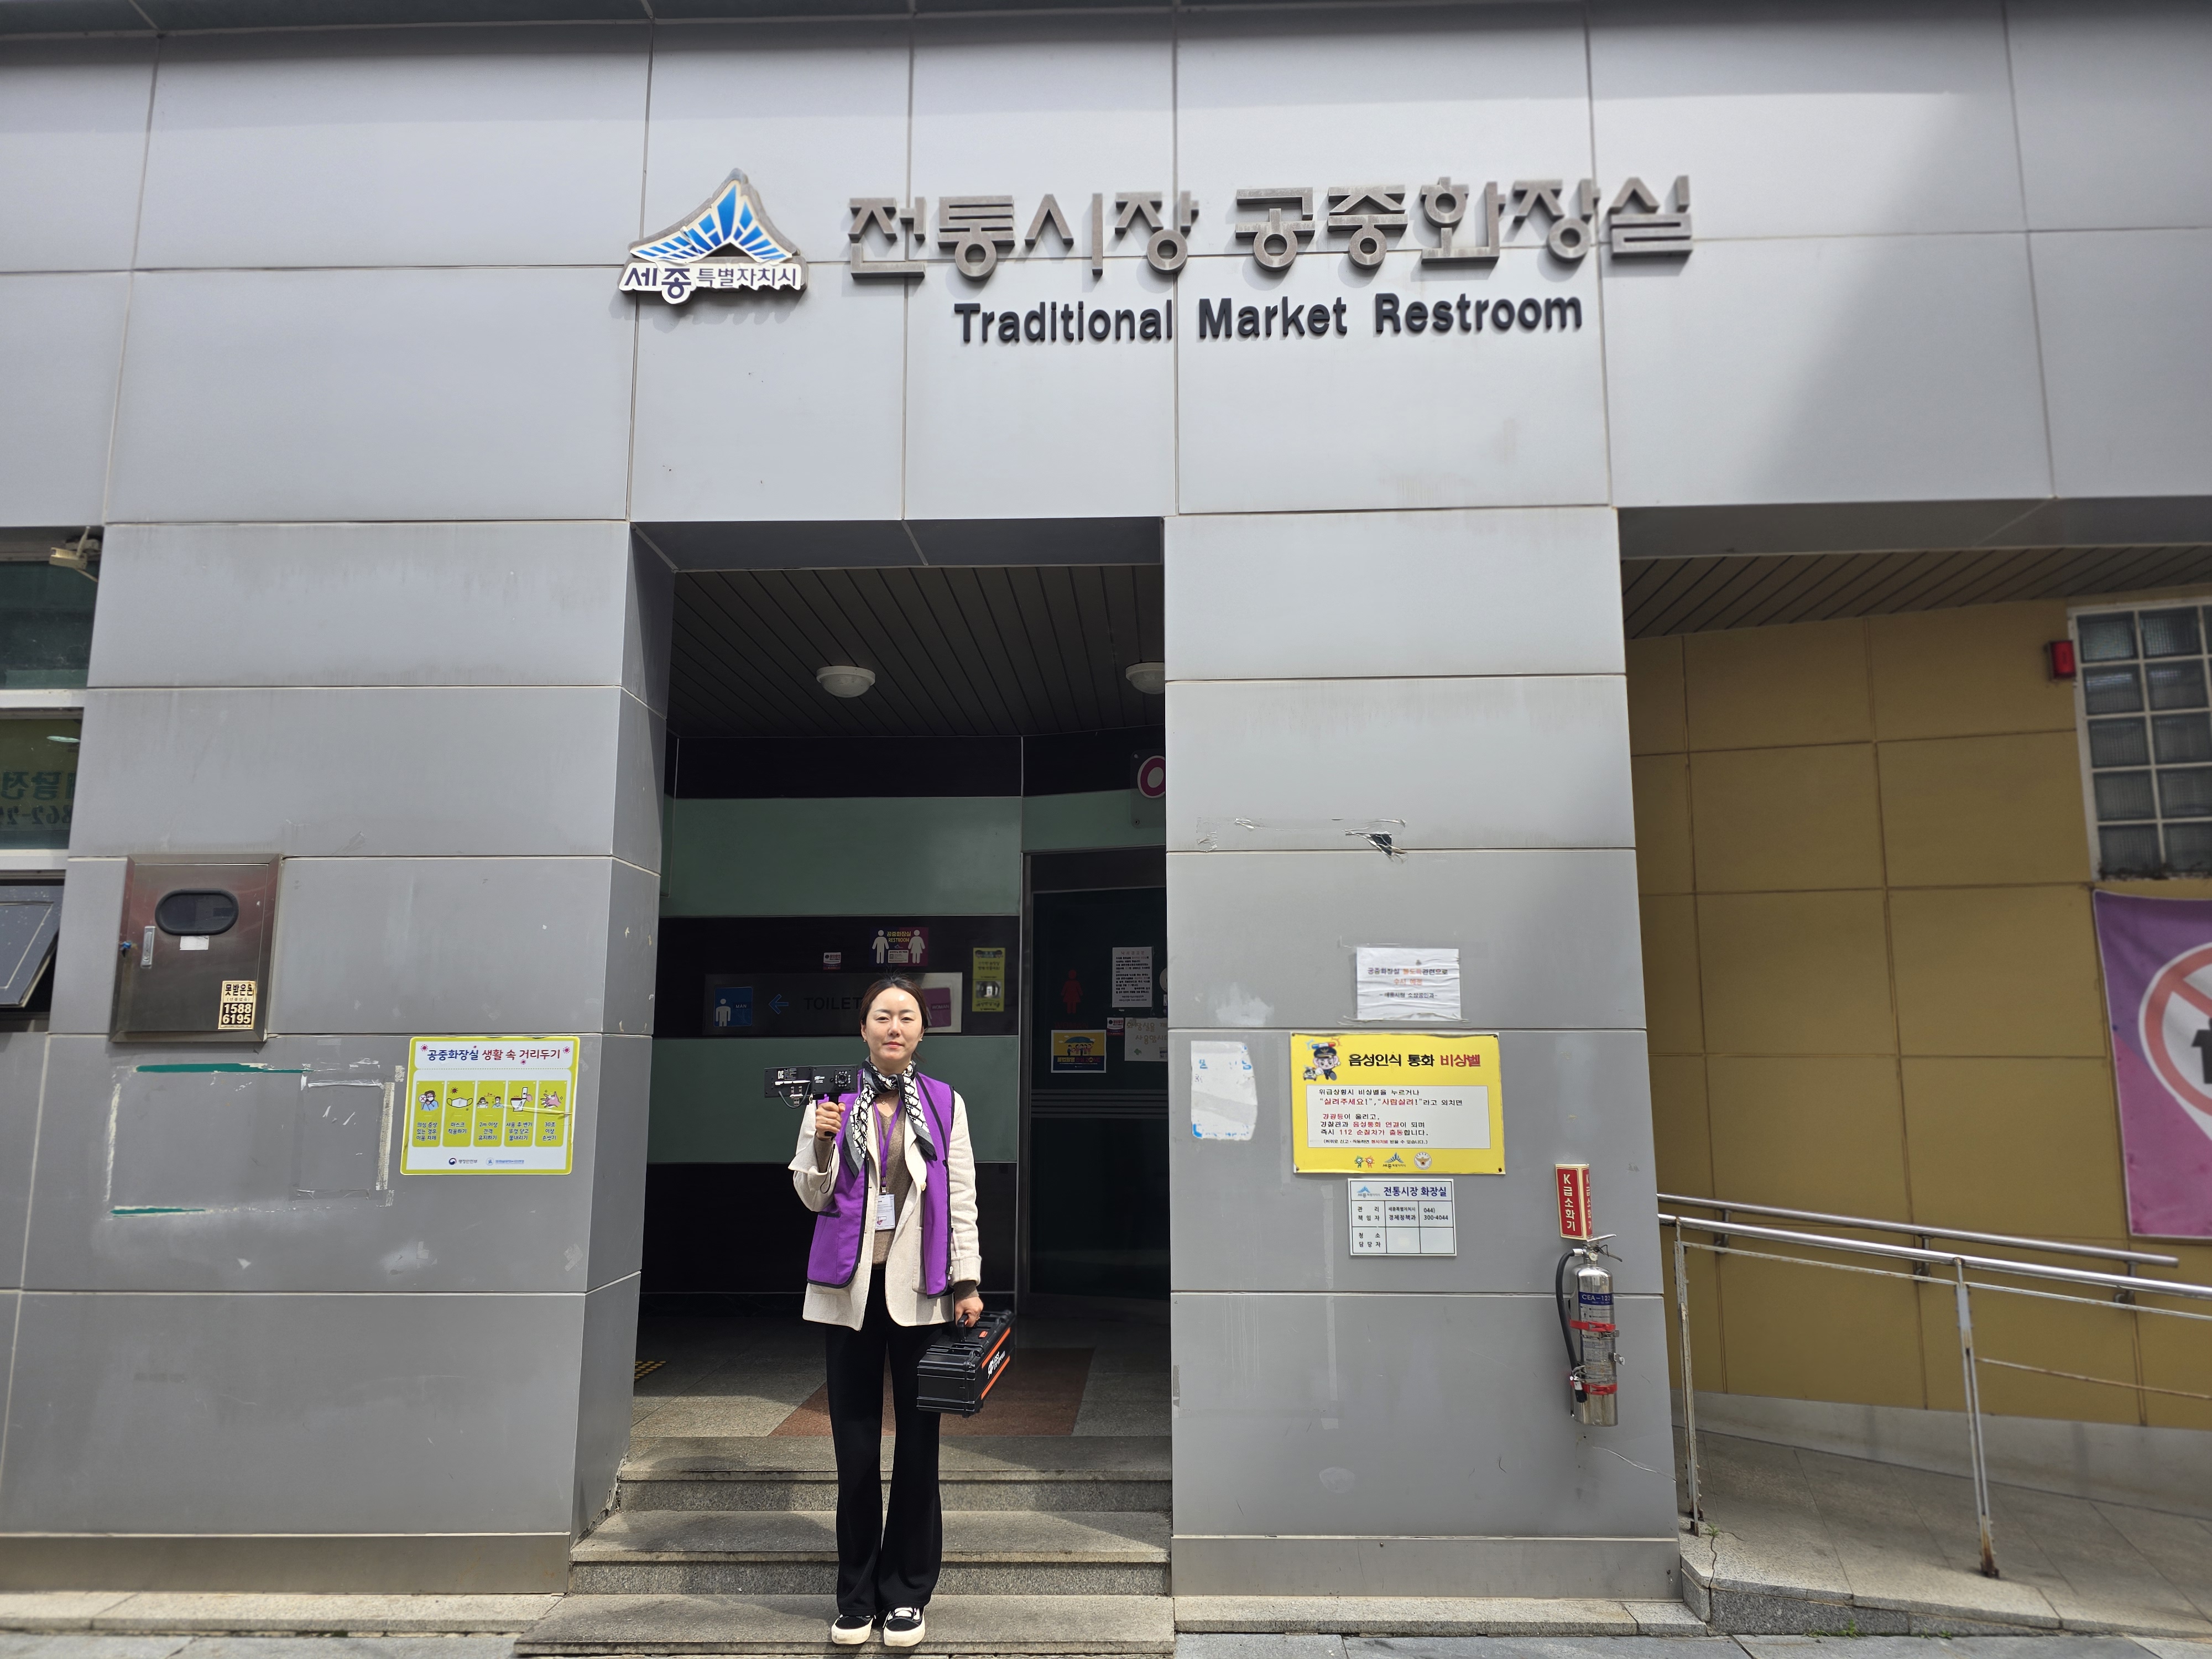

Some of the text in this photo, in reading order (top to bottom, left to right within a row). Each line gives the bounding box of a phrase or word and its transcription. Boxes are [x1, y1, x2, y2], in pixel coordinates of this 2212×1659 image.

[848, 175, 1693, 281] 전통시장 공중화장실
[624, 268, 796, 299] 세종특별자치시
[954, 293, 1583, 343] Traditional Market Restroom
[224, 1003, 252, 1014] 1588
[803, 997, 863, 1011] TOILET
[222, 1014, 251, 1024] 6195
[427, 1049, 561, 1061] 공중화장실 생활 속 거리두기
[1348, 1053, 1481, 1067] 음성인식 통화 비상벨
[1383, 1186, 1447, 1197] 전통시장 화장실
[1563, 1173, 1575, 1232] K급소화기
